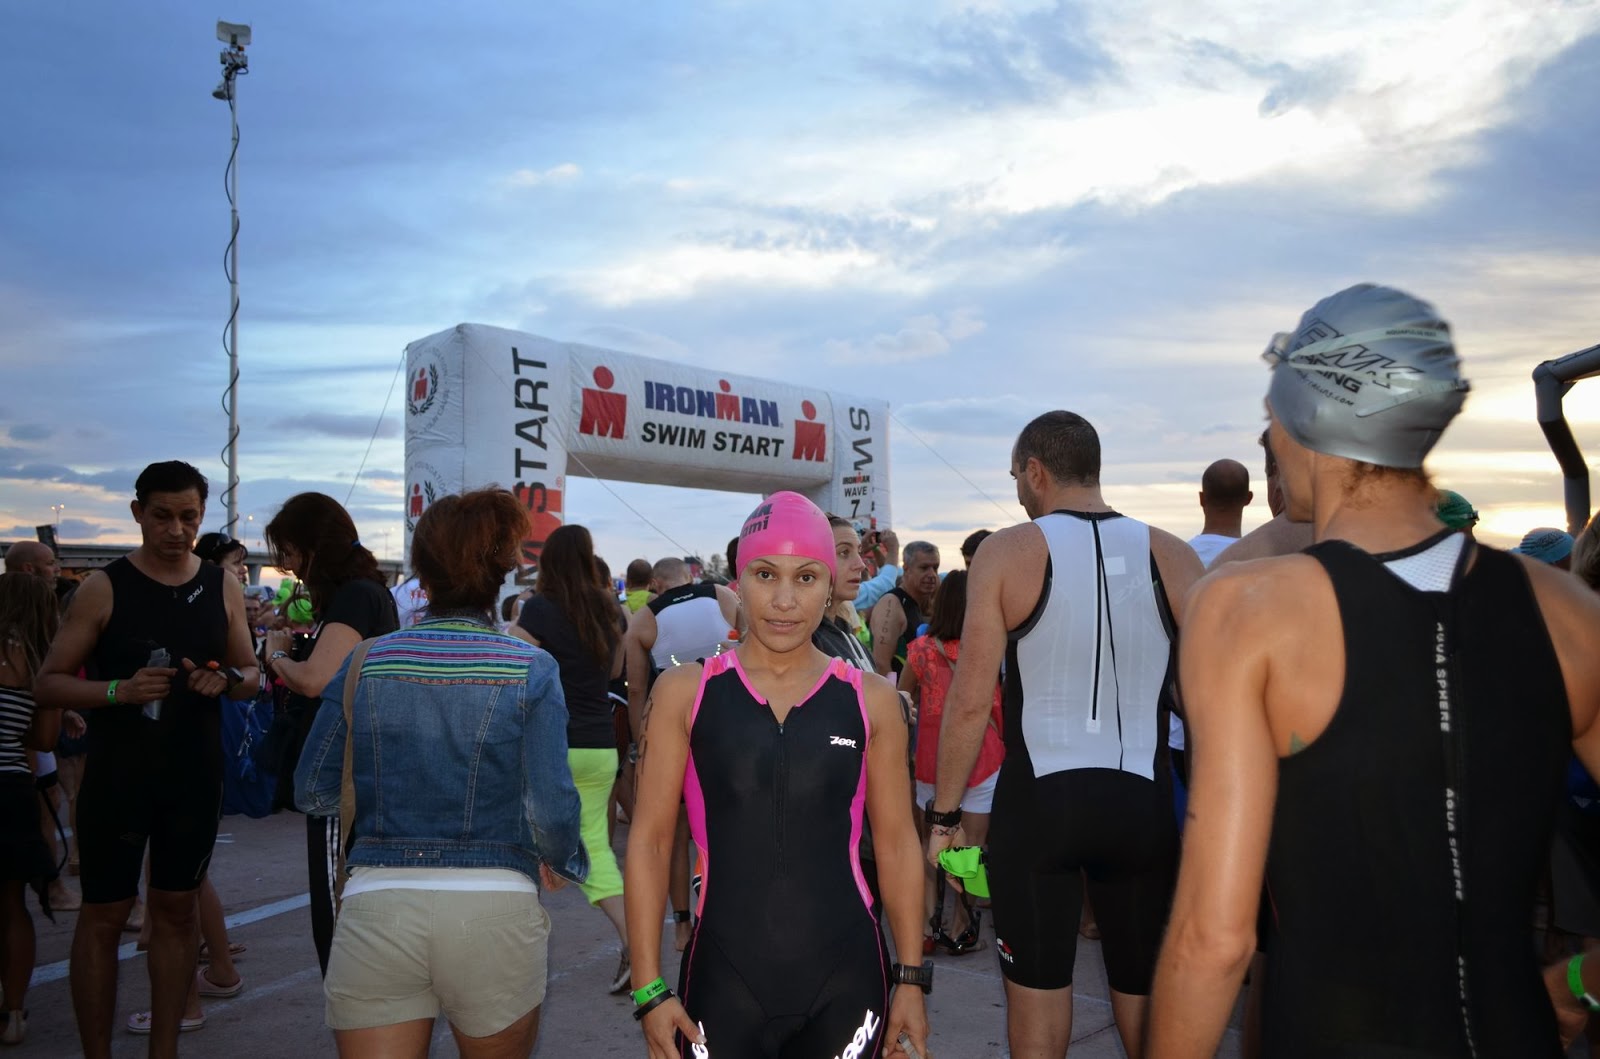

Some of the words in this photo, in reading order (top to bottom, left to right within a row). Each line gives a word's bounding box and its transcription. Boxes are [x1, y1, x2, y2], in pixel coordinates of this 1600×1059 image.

[644, 379, 780, 428] IRONMAN
[511, 346, 549, 514] START
[641, 421, 706, 449] SWIM
[712, 431, 784, 457] START
[844, 486, 868, 497] WAVE
[851, 499, 860, 519] 7
[187, 585, 203, 603] 2XU
[1436, 668, 1450, 732] SPHERE
